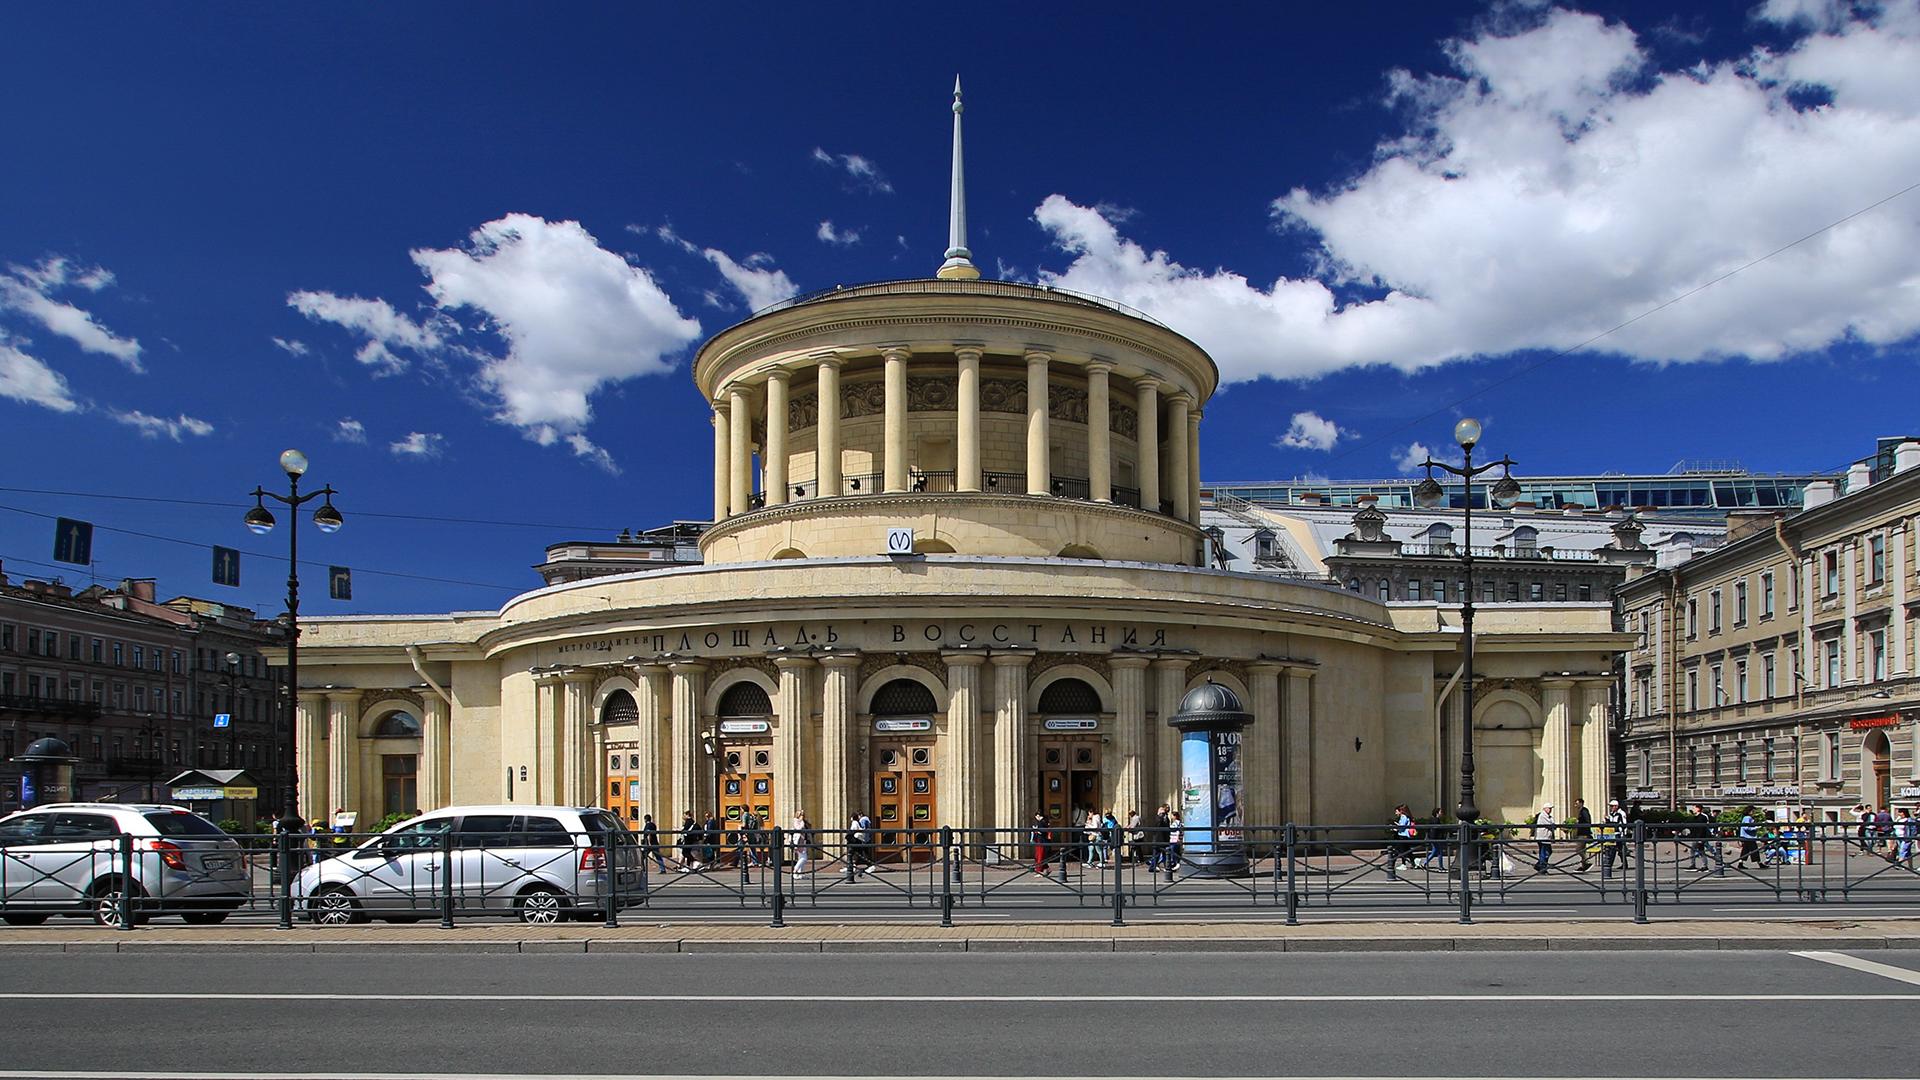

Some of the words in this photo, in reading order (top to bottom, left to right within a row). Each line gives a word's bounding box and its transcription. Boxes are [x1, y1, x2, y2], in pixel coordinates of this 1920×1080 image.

[558, 636, 649, 653] МЕТРОПОЛИТЕН
[653, 625, 838, 651] ПЛОЩАДЬ
[892, 624, 1165, 646] ВОССТАНИЯ
